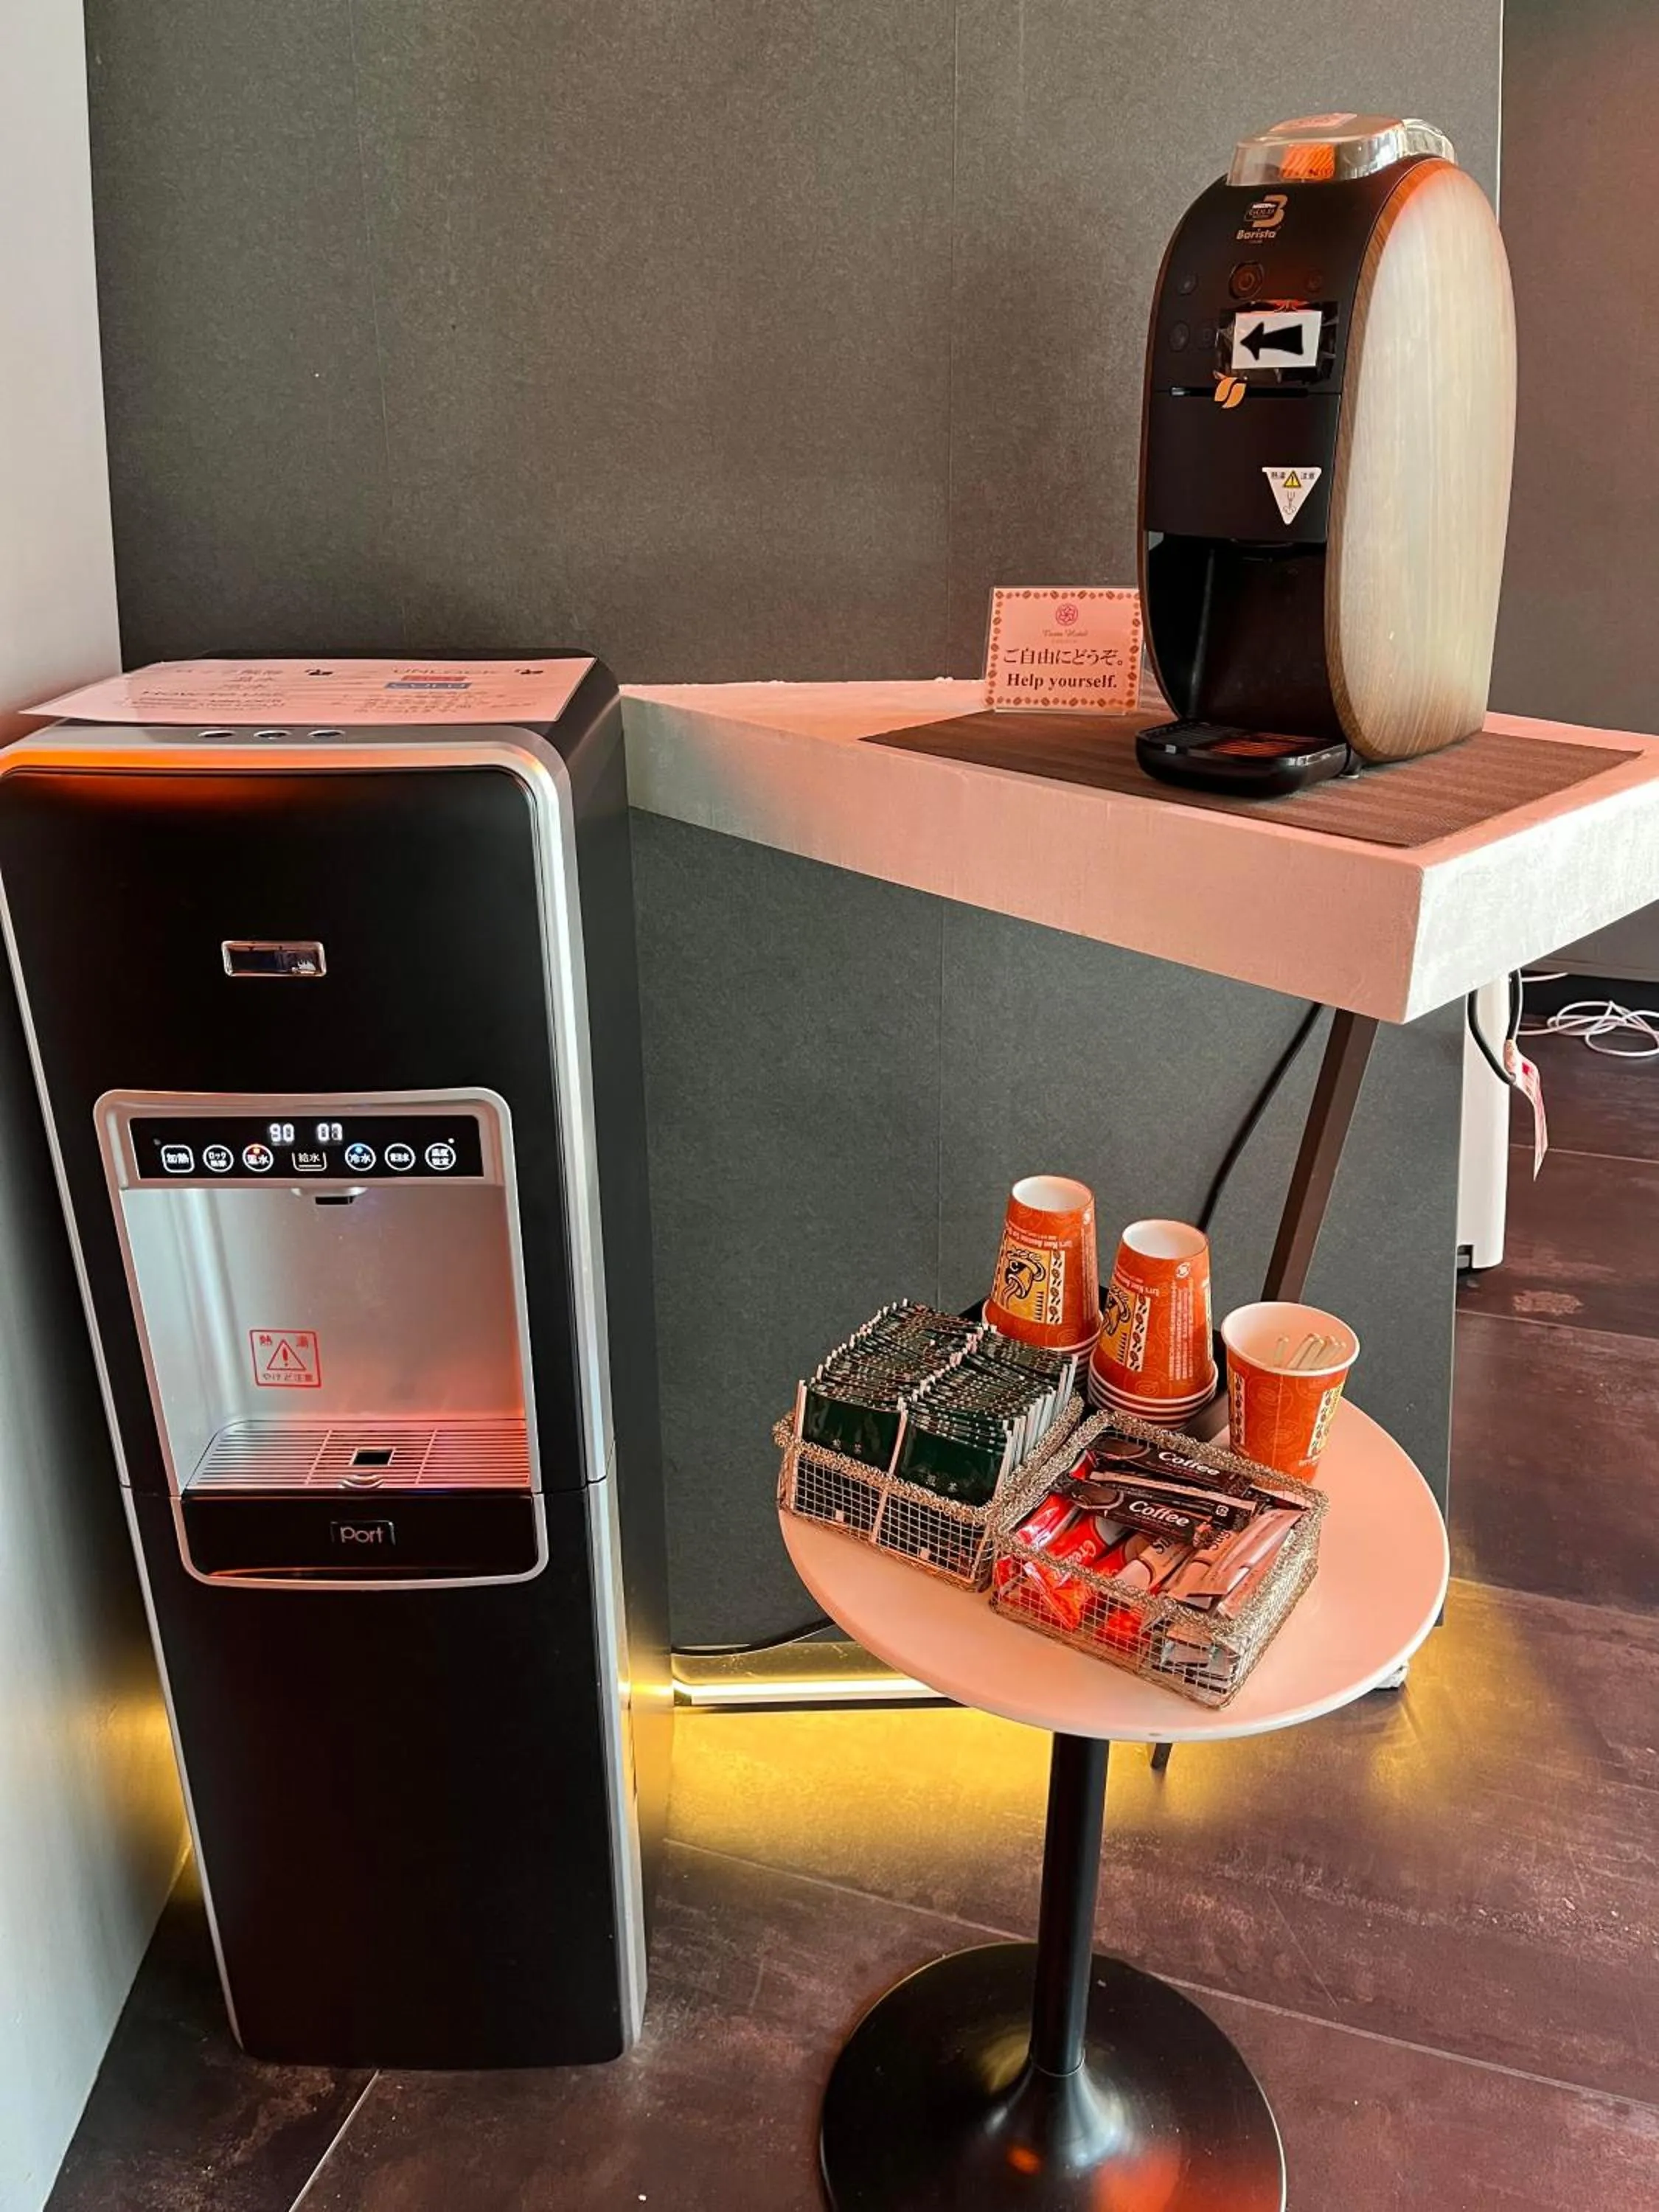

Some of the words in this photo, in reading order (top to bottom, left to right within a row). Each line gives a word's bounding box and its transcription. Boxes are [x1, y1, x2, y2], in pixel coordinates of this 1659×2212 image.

[1237, 229, 1276, 240] Barista
[1004, 647, 1123, 666] ご自由にどうぞ。
[1007, 673, 1043, 690] Help
[1048, 674, 1117, 691] yourself.
[1158, 1451, 1220, 1475] Coffee
[1129, 1500, 1190, 1527] Coffee
[340, 1526, 384, 1543] Port
